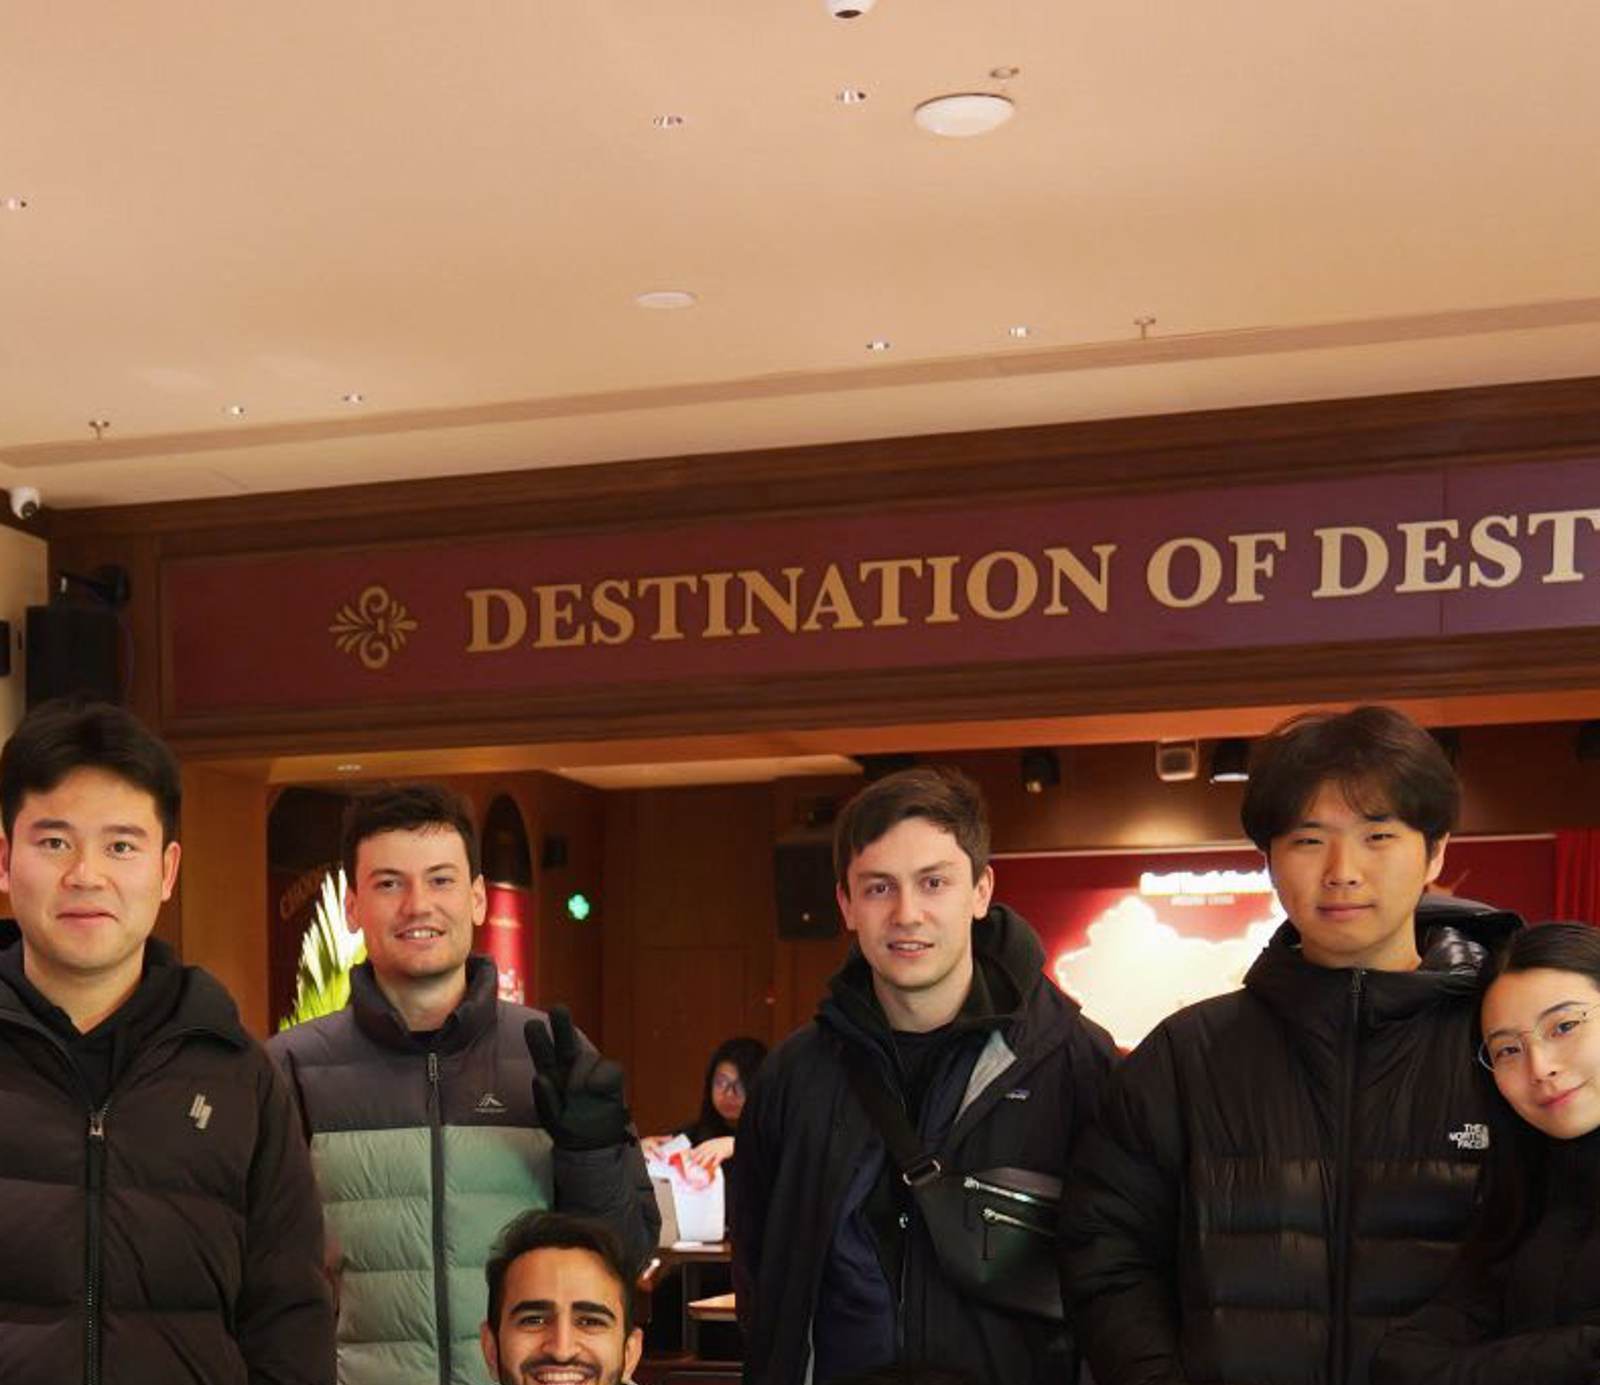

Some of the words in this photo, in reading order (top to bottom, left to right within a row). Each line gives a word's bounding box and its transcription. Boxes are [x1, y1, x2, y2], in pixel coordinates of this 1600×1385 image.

[465, 544, 1118, 653] DESTINATION
[1146, 531, 1287, 608] OF
[1311, 508, 1600, 598] DEST
